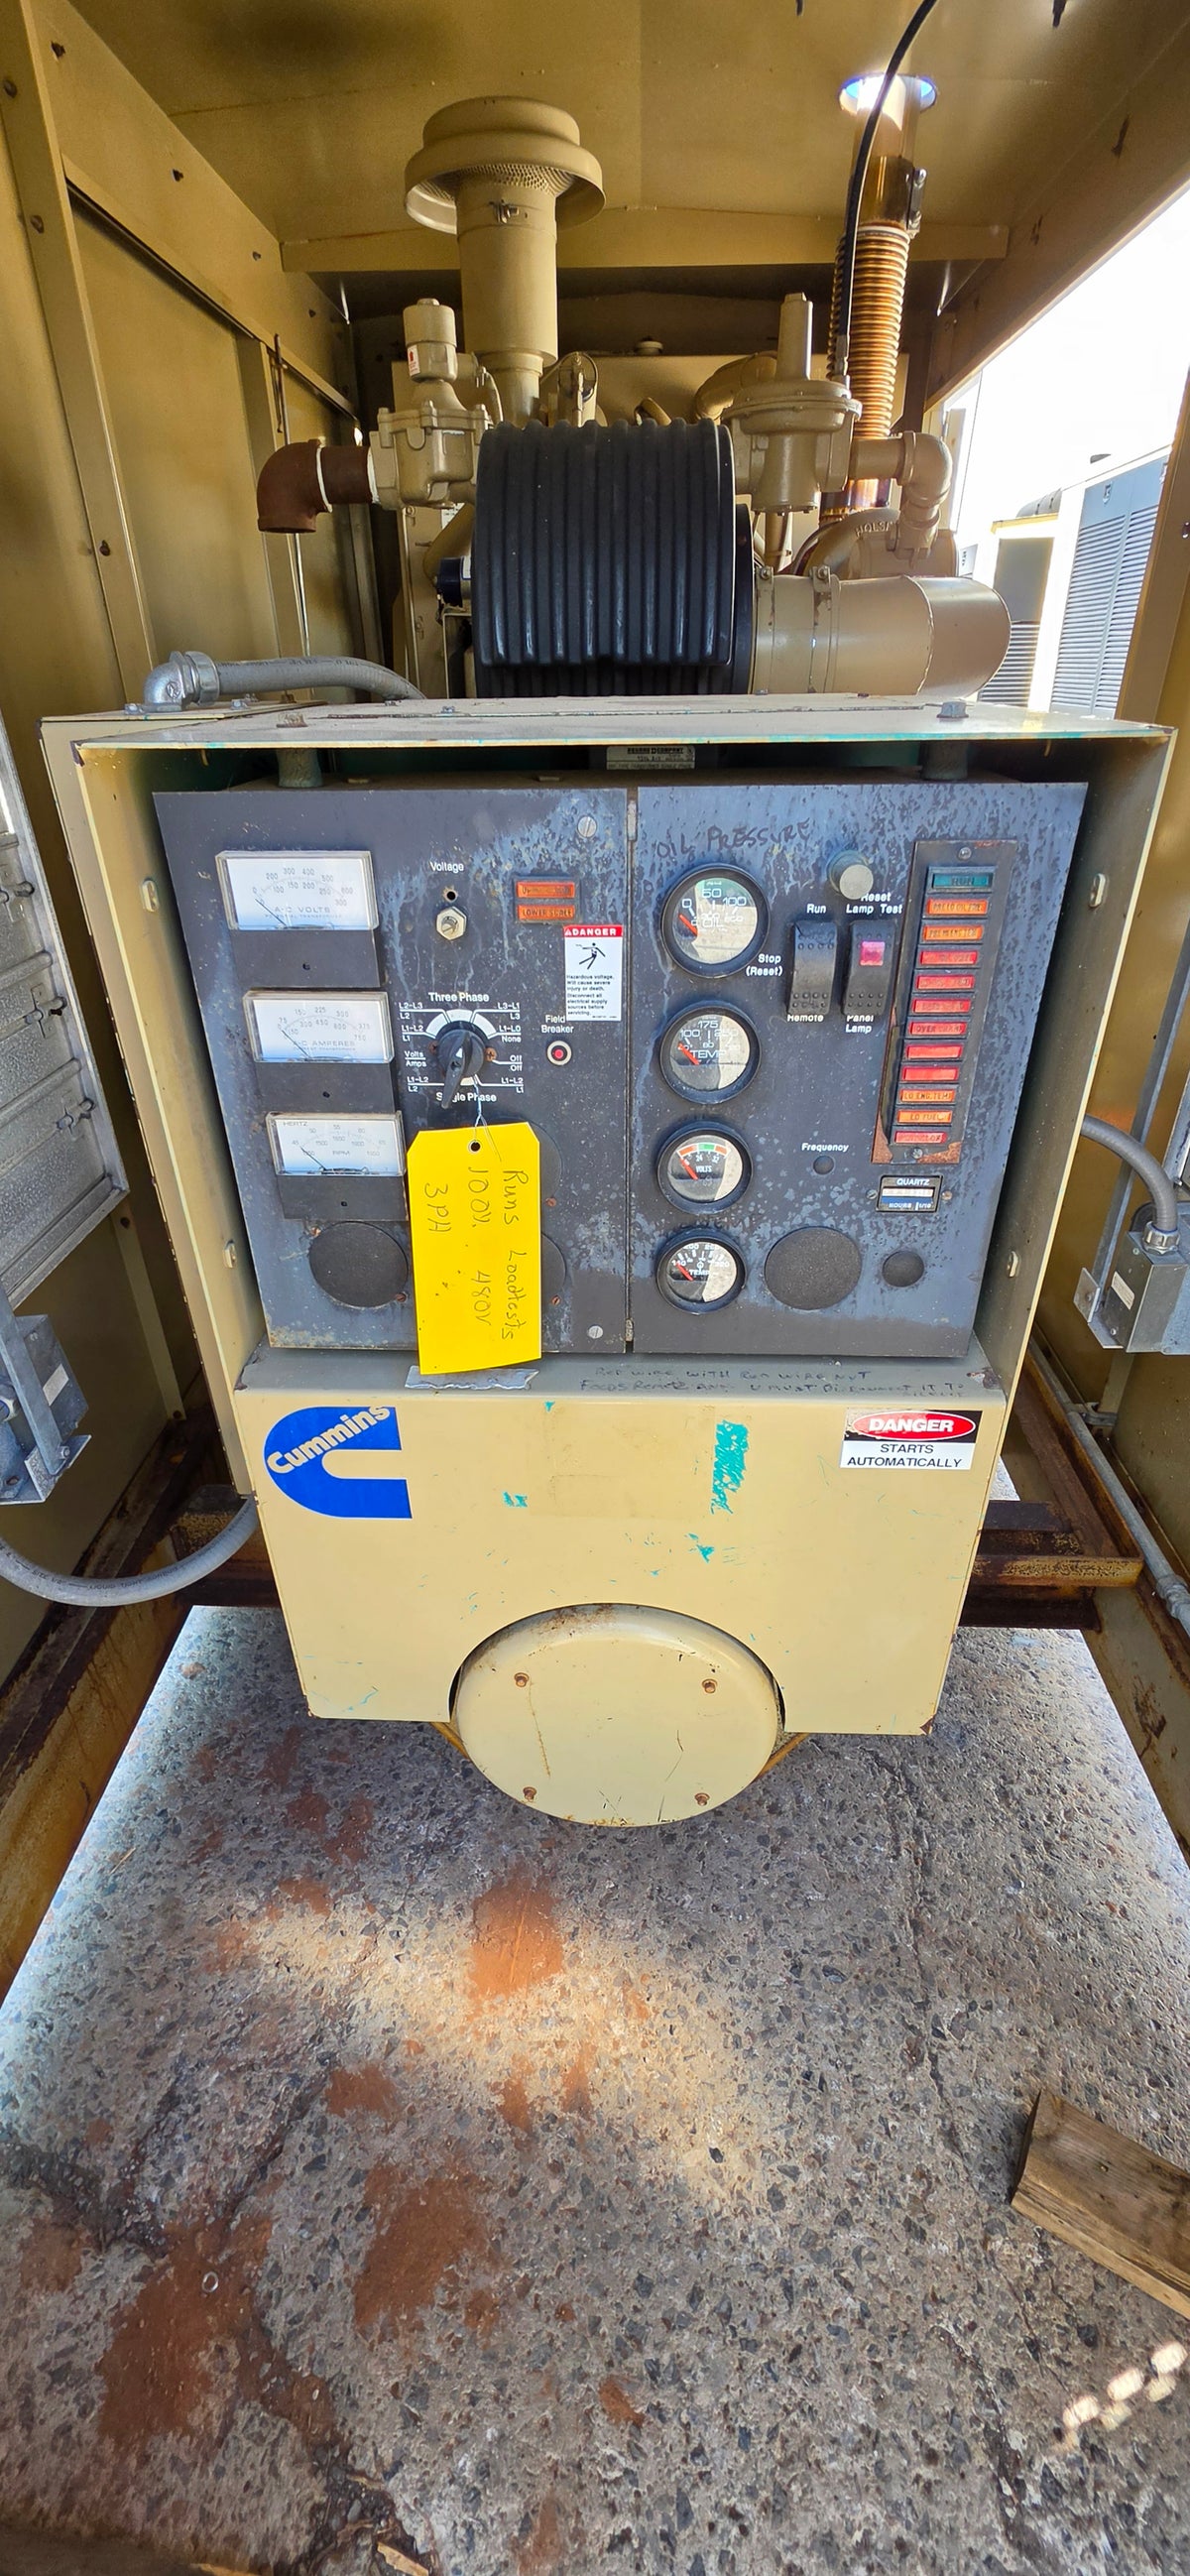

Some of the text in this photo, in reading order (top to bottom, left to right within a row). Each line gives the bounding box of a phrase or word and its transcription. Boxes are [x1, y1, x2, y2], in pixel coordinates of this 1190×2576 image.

[657, 818, 810, 858] OIL PRESSURE
[429, 861, 464, 874] Voltage
[302, 881, 315, 890] 200
[681, 889, 747, 908] 0 50 100
[807, 904, 826, 914] Run
[846, 904, 902, 915] Lamp Test
[702, 918, 724, 927] OIL
[758, 953, 780, 964] Stop
[746, 965, 782, 976] (Reset)
[428, 992, 490, 1003] Three Phase
[545, 1014, 566, 1023] Field
[846, 1024, 872, 1034] Lamp
[436, 1092, 497, 1103] Sgle Phase
[801, 1142, 849, 1153] Frequency
[503, 1170, 530, 1225] Runs
[471, 1270, 492, 1325] 480V
[869, 1418, 954, 1432] DANGER
[267, 1407, 391, 1474] Cummins
[880, 1443, 934, 1454] STARTS
[847, 1456, 963, 1468] AUTOMATICALLY
